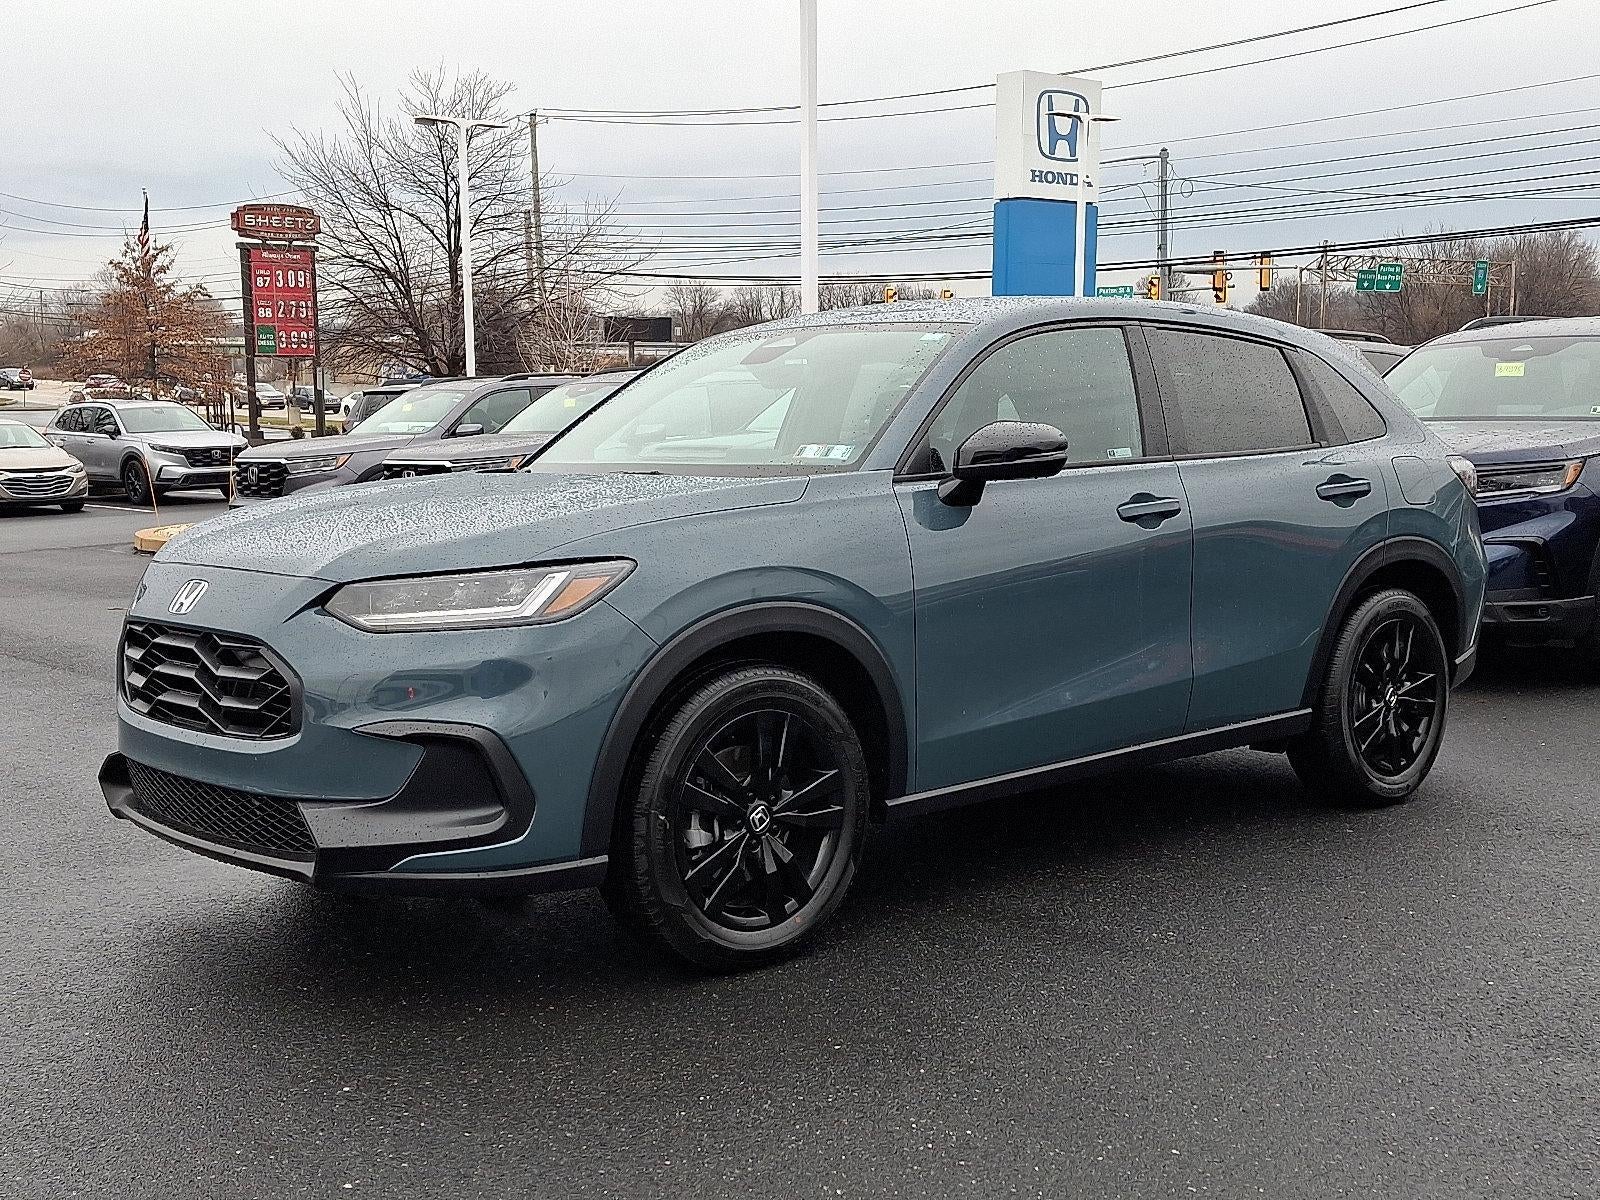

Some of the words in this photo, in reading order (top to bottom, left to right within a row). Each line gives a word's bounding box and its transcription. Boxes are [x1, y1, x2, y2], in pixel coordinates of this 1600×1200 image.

[244, 214, 315, 230] SHEETZ
[261, 251, 284, 260] Always
[256, 276, 271, 288] 87
[275, 269, 305, 288] 3.09
